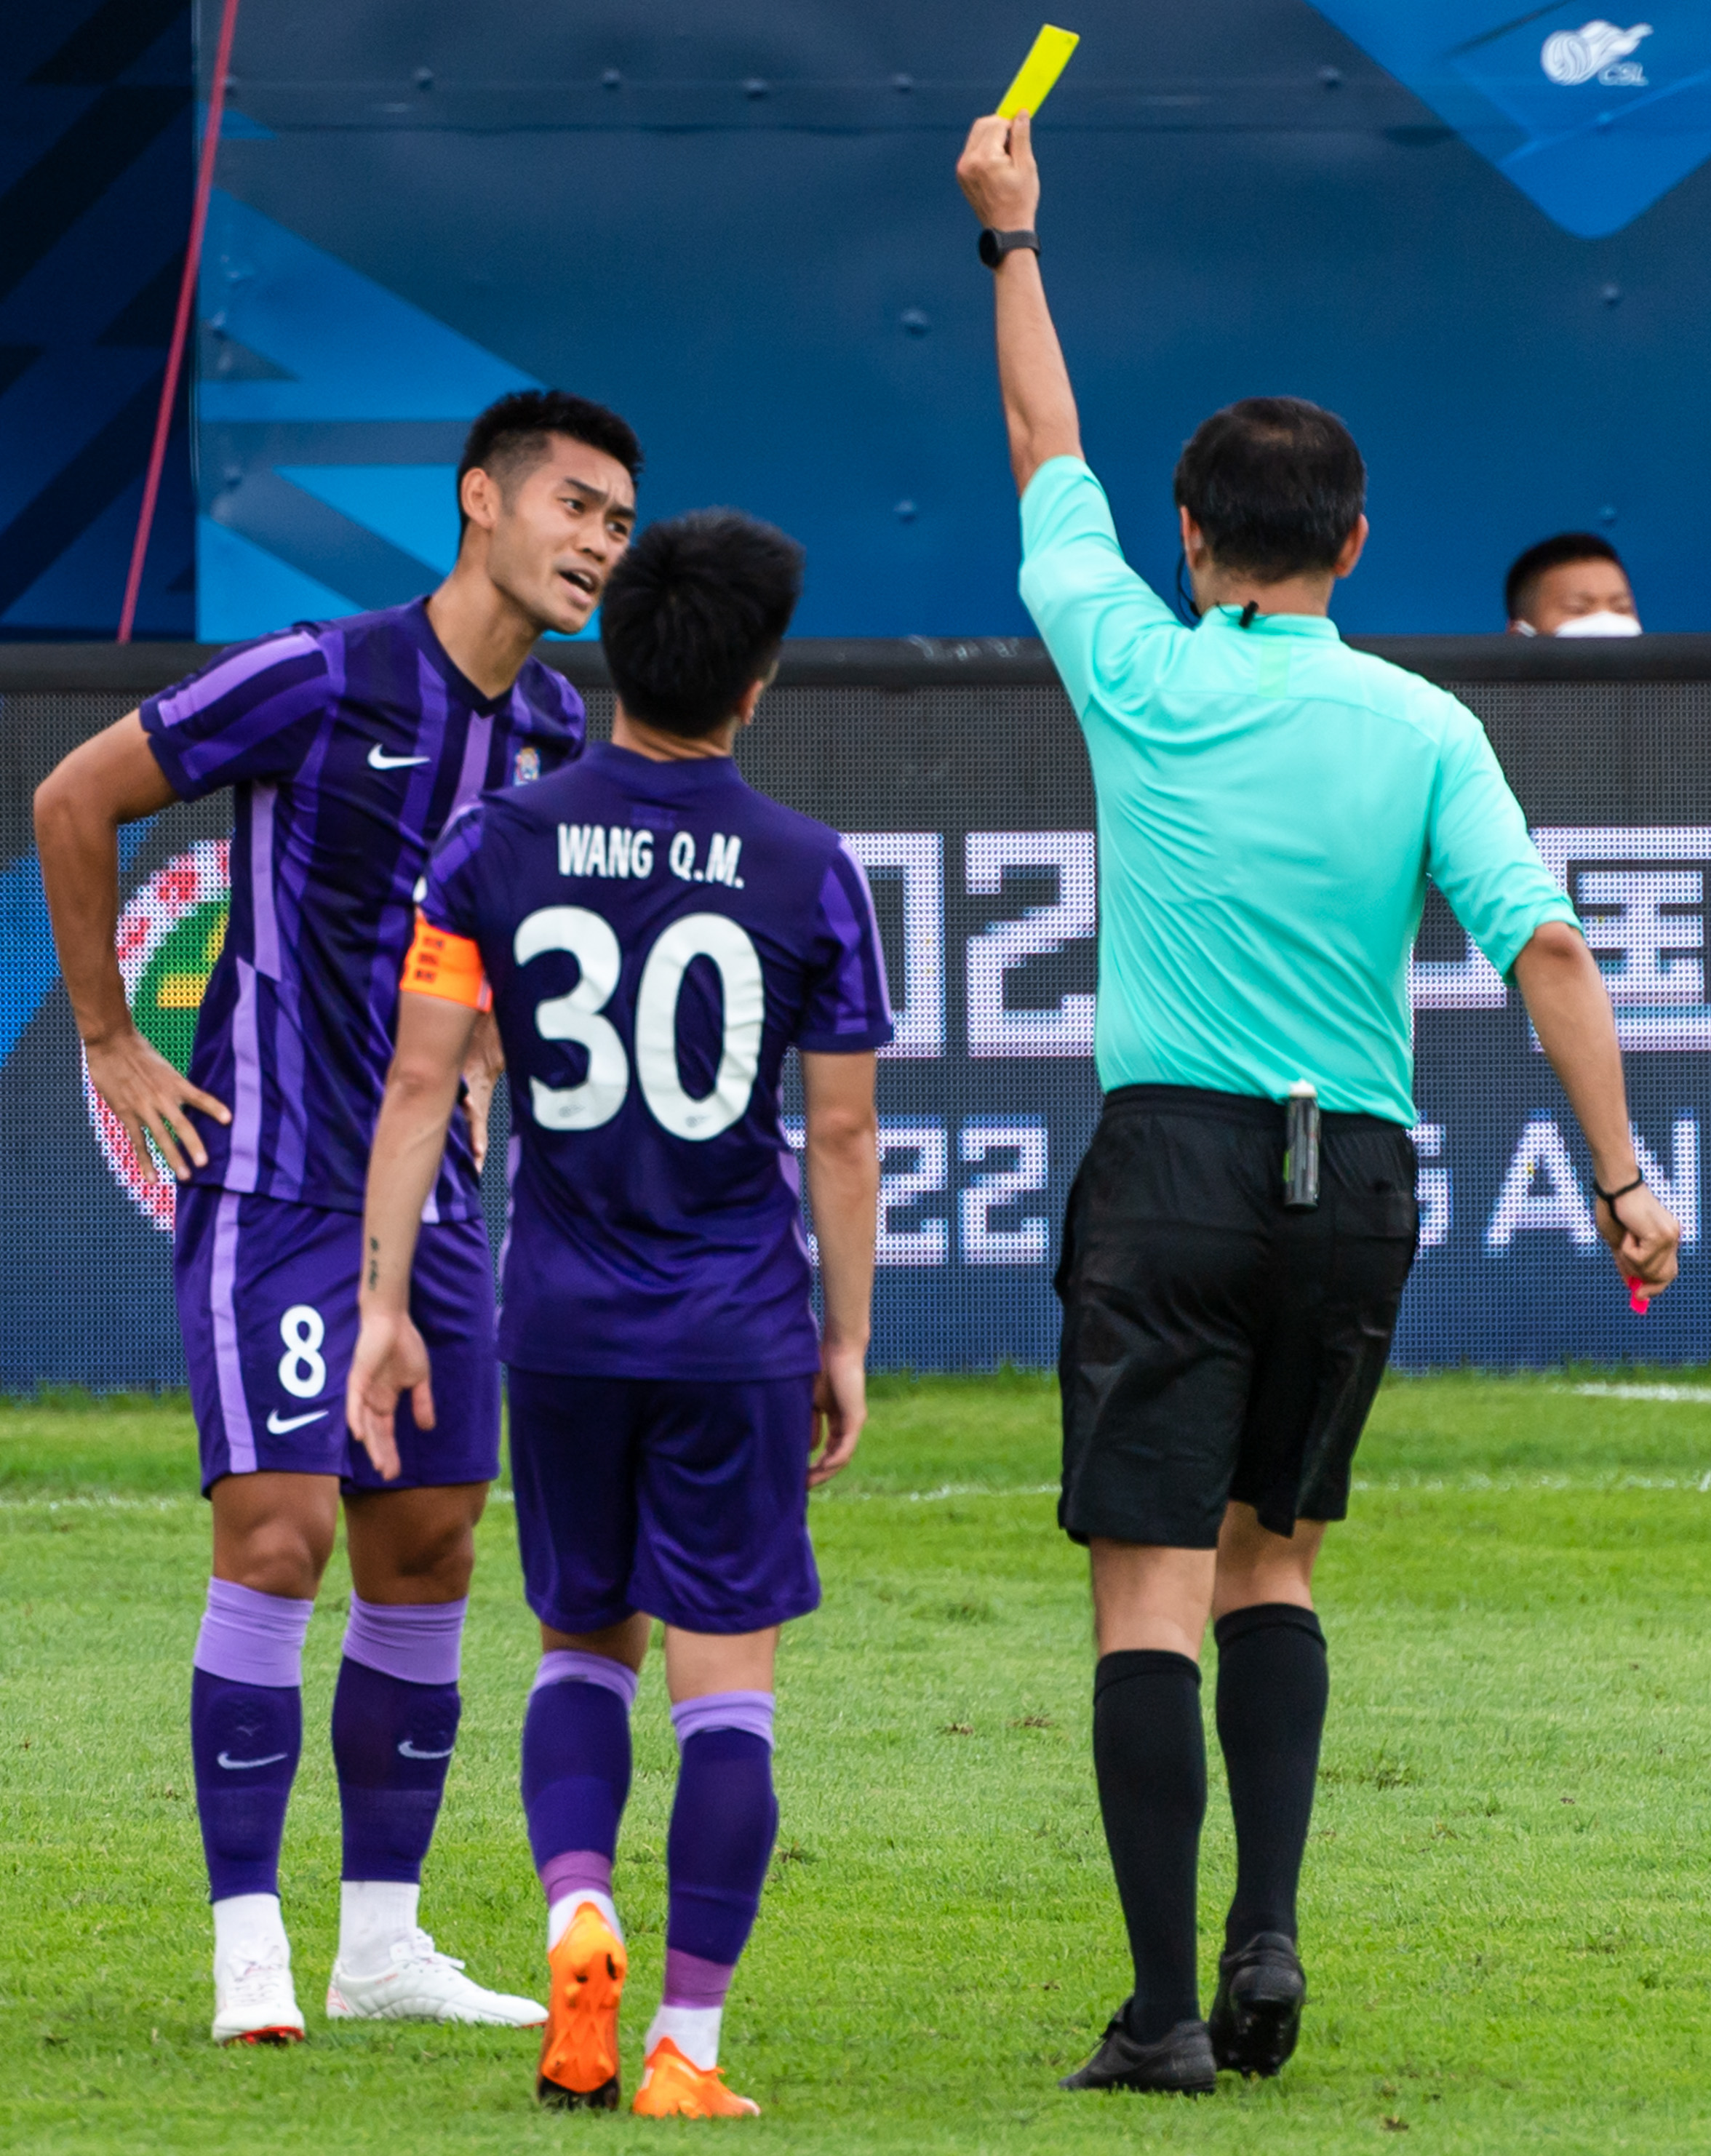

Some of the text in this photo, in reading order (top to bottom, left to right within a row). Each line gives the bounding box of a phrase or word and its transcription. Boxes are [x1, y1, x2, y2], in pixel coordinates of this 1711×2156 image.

[557, 822, 745, 889] WANG Q.M.
[514, 904, 765, 1142] 30
[873, 1114, 1050, 1266] 22
[278, 1303, 327, 1399] 8
